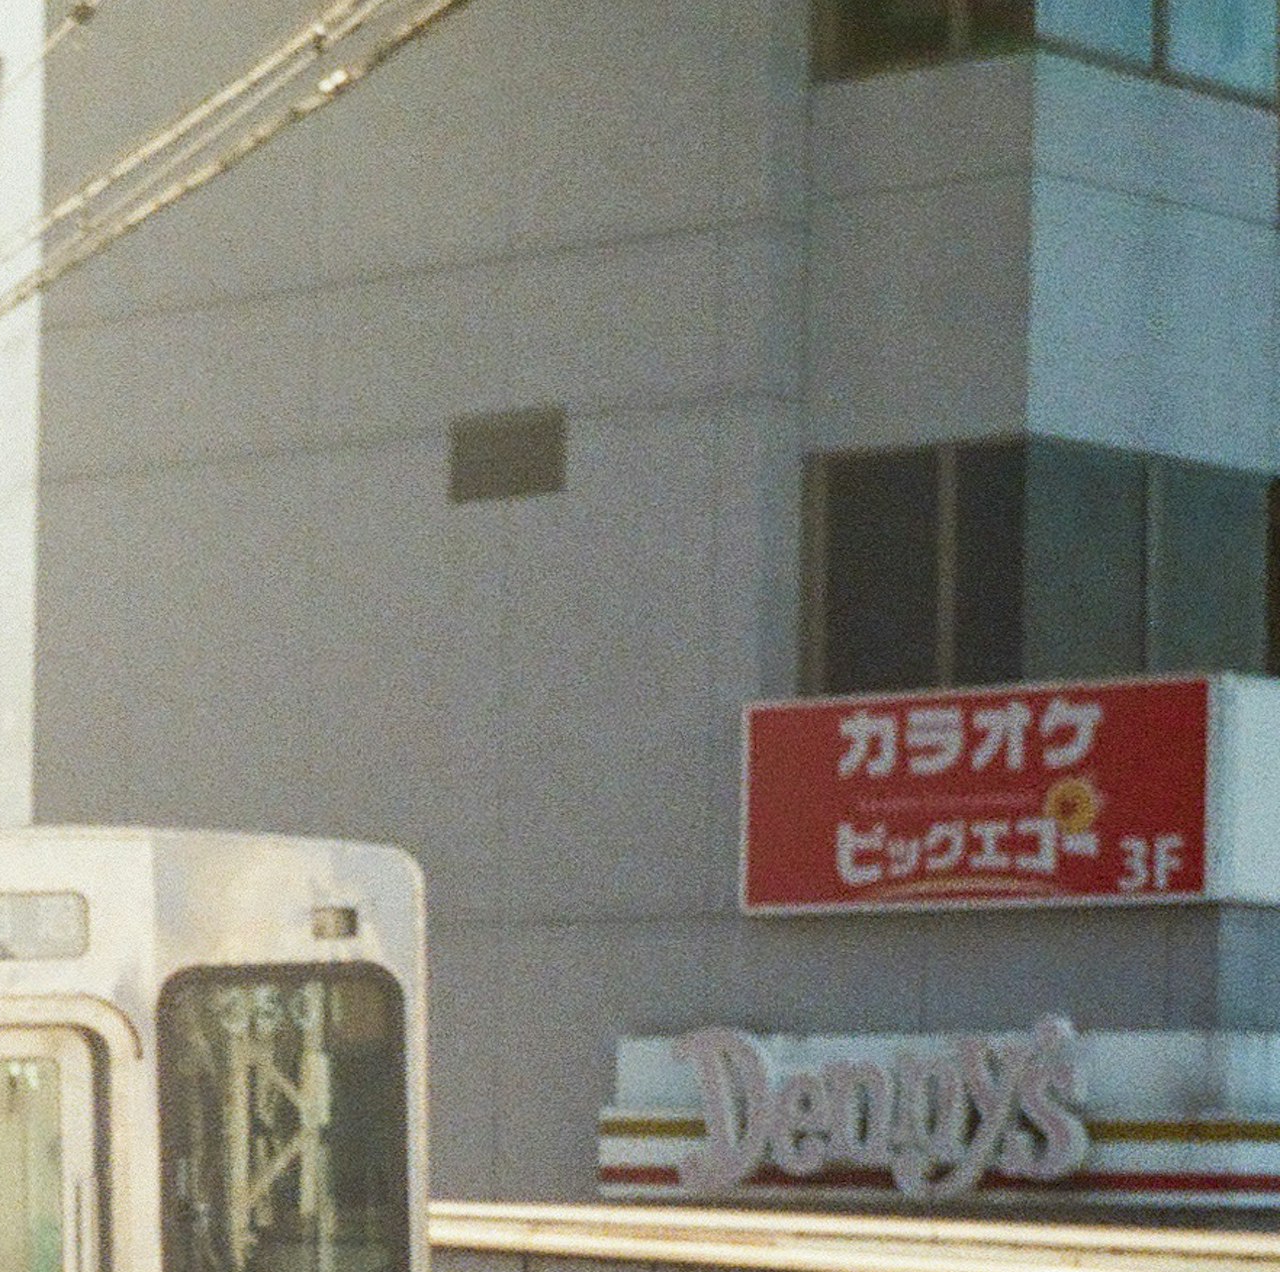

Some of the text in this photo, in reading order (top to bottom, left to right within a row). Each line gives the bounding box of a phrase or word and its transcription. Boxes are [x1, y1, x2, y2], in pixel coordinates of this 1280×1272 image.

[839, 699, 1102, 777] カラオケ
[1119, 834, 1183, 890] 3F
[676, 1015, 1090, 1199] Denny's
